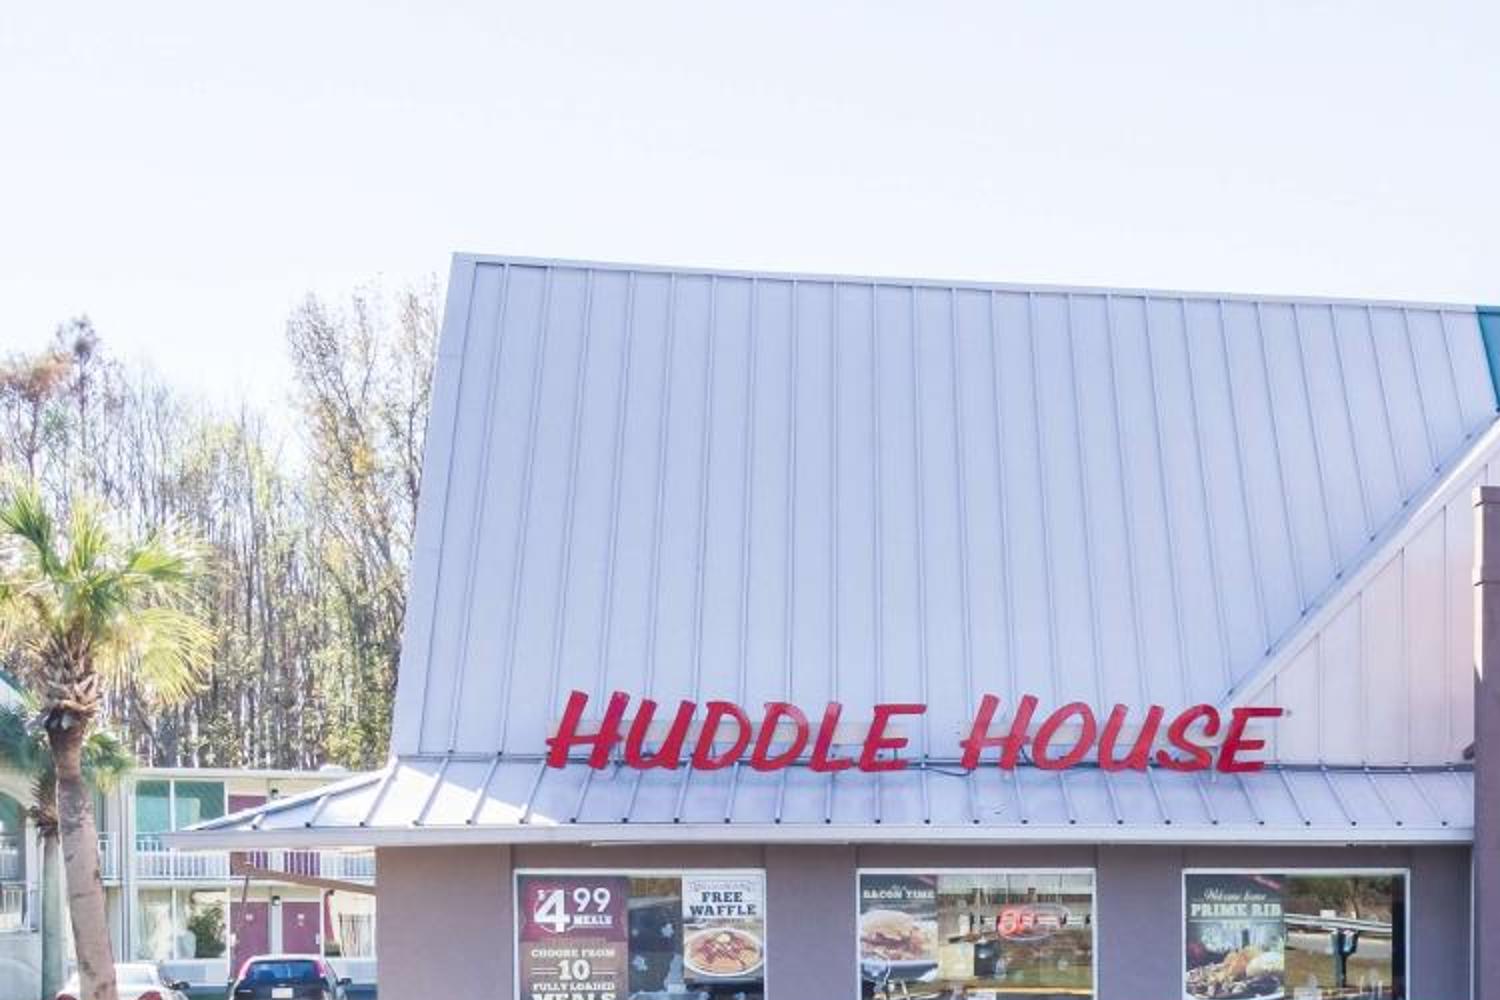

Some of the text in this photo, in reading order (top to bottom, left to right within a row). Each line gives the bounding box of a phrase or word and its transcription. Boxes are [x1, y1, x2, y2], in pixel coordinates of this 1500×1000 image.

[546, 690, 1284, 772] HUDDLE HOUSE
[701, 891, 743, 903] FREE
[689, 904, 757, 917] WAFFLE
[1190, 904, 1248, 917] PRIME
[531, 948, 579, 959] CHOOSE
[558, 959, 591, 981] 10
